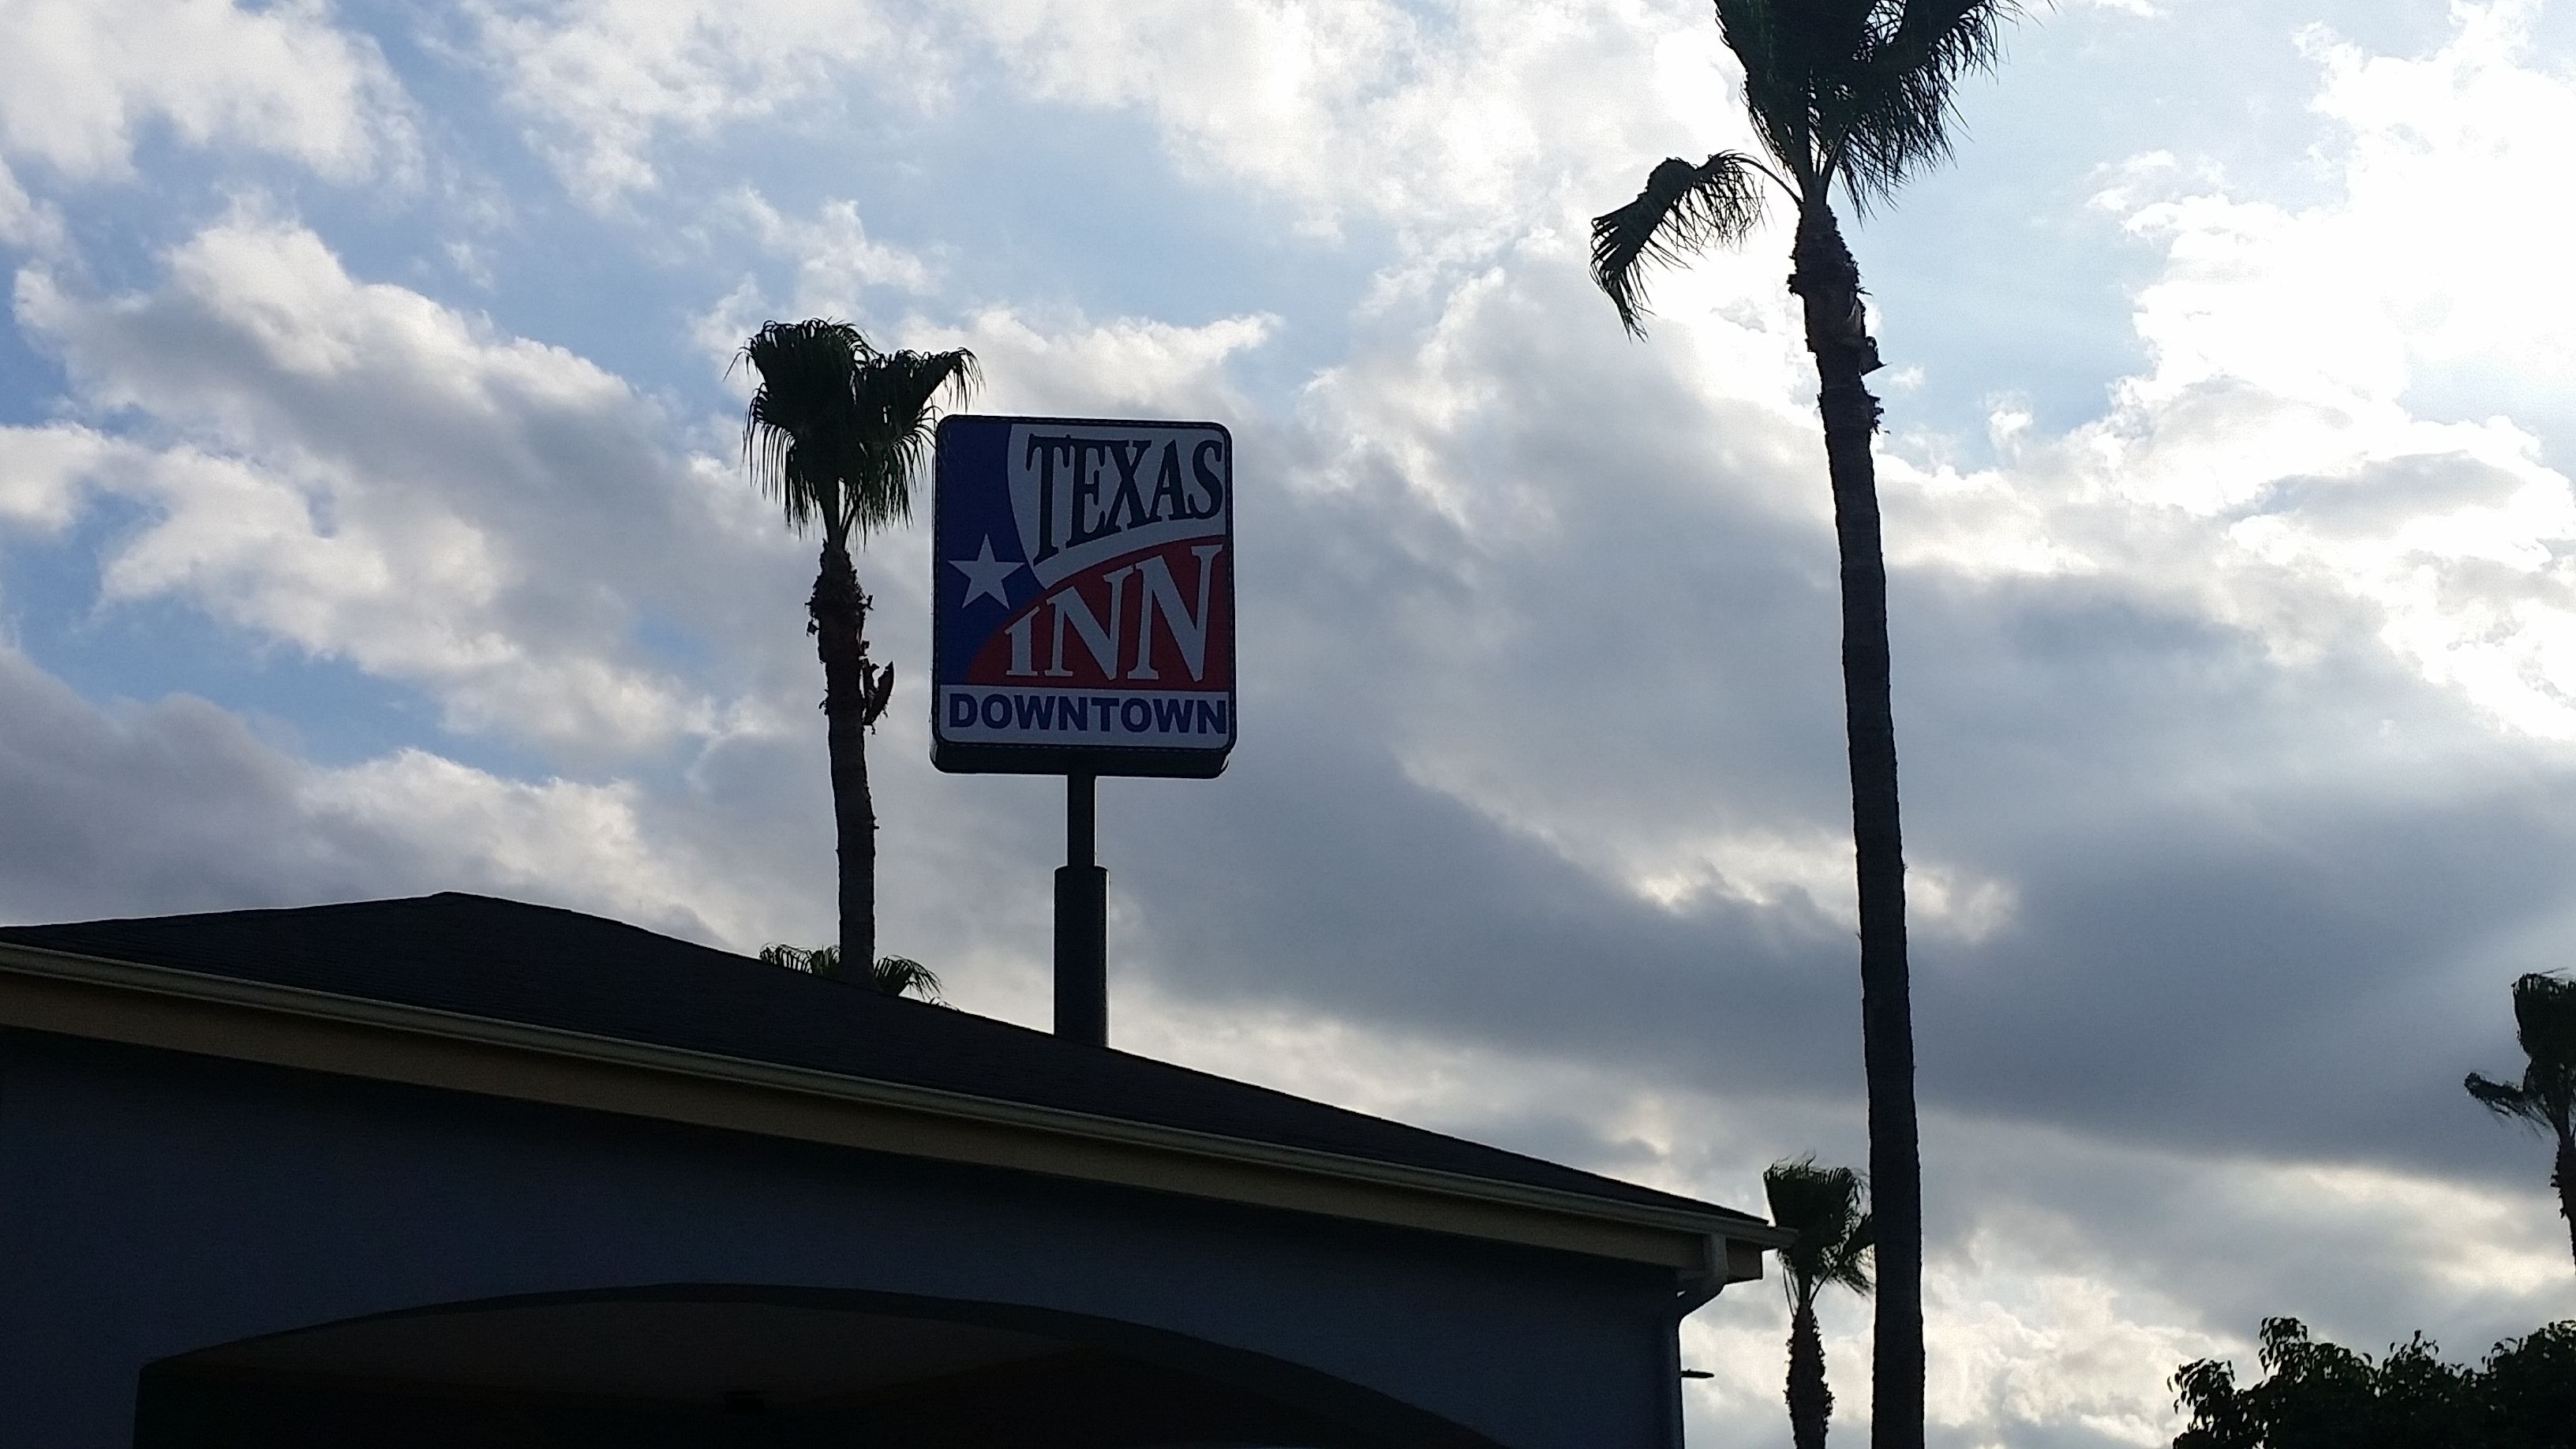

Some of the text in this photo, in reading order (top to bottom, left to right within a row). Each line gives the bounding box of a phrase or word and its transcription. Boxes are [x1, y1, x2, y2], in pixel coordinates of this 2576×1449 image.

[1026, 433, 1223, 567] TEXAS
[1005, 543, 1223, 682] INN
[949, 693, 1227, 734] DOWNTOWN
